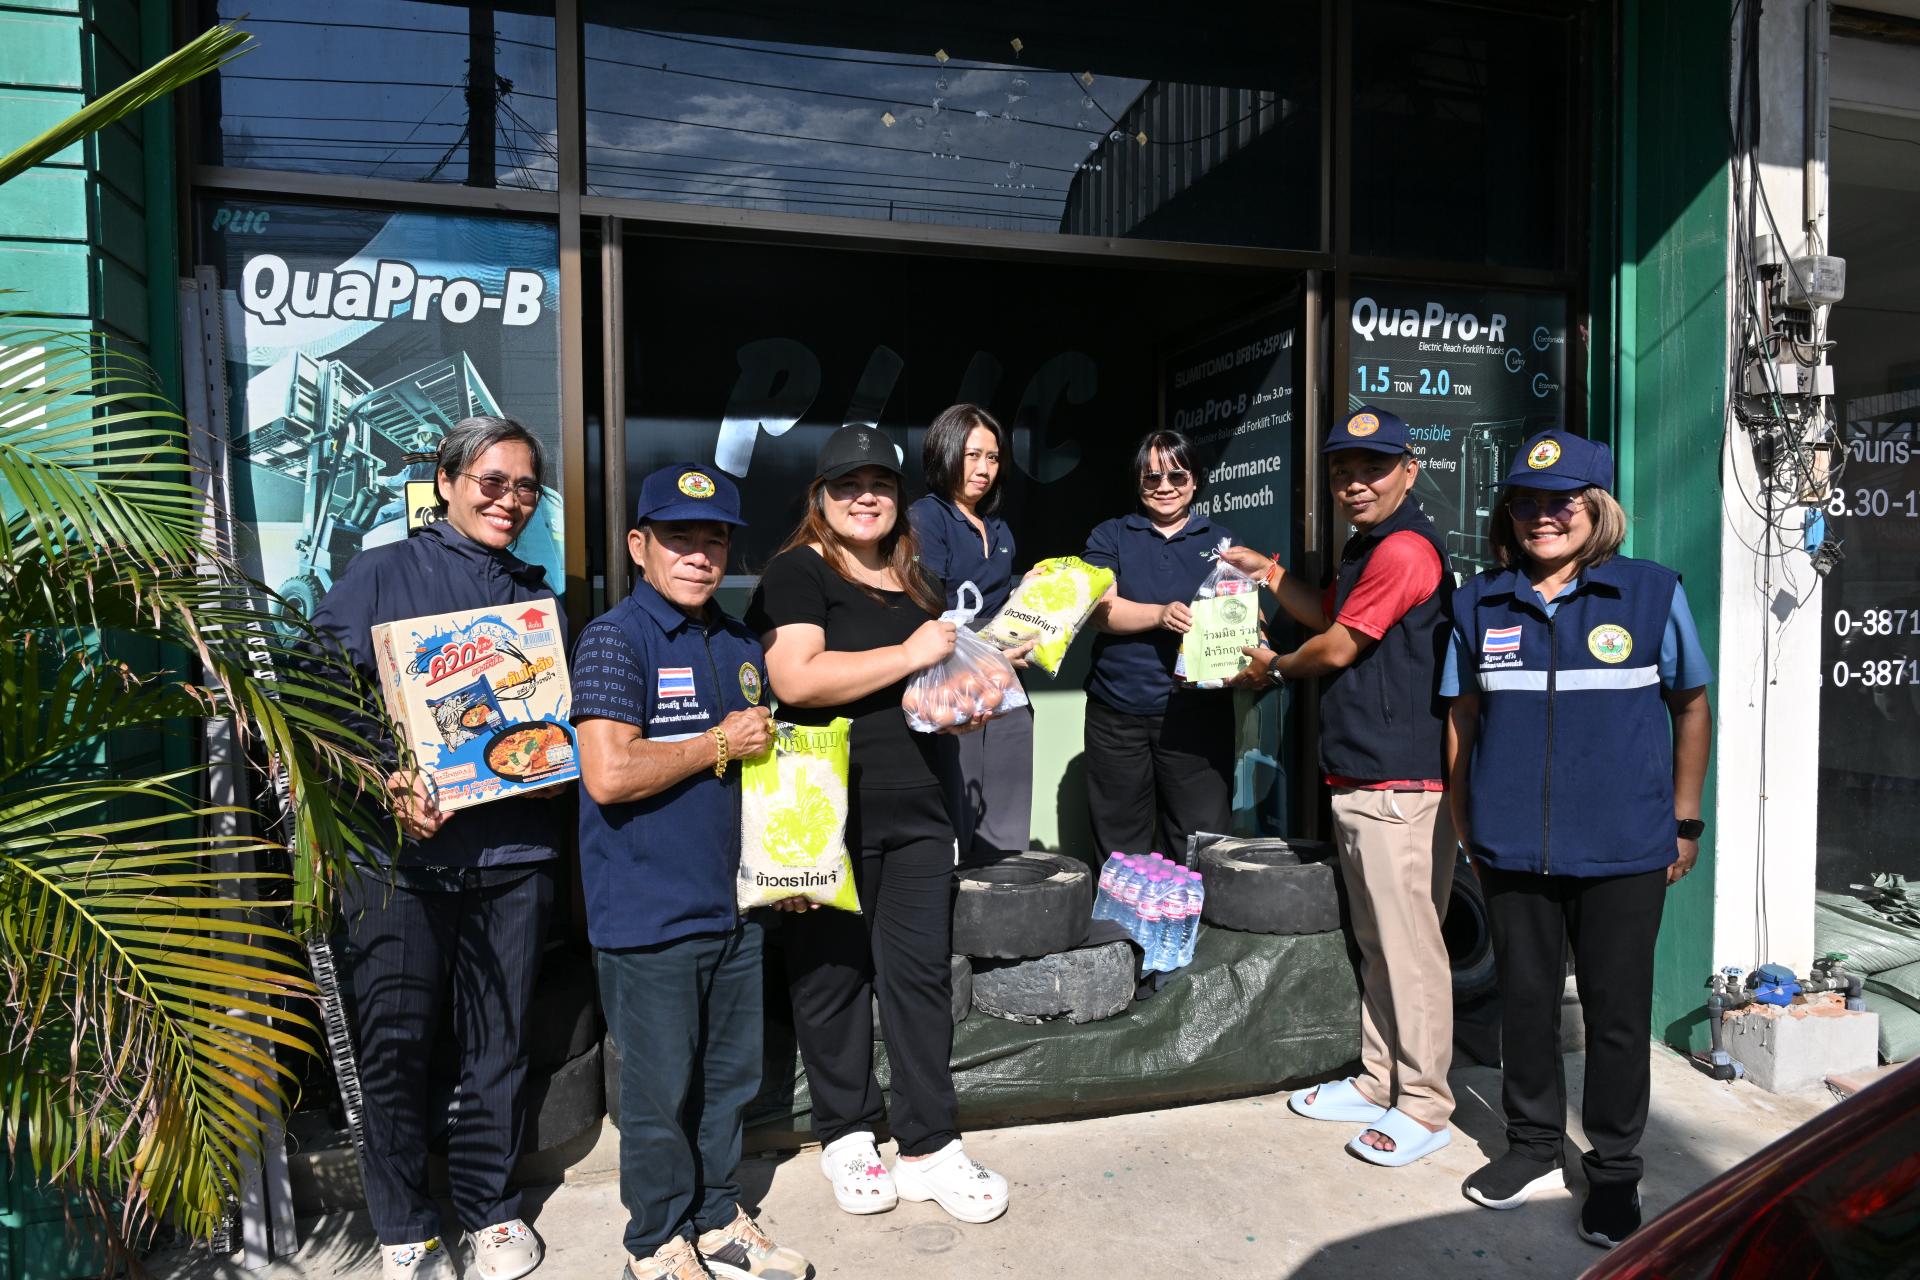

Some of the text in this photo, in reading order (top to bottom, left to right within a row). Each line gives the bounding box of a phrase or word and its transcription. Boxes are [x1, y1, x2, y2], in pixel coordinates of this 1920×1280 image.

[212, 208, 270, 234] PLIC
[240, 253, 545, 325] QuaPro-B
[1351, 296, 1507, 342] QuaPro-R
[1418, 342, 1504, 355] Electric Reach Forklift Trucks
[1357, 365, 1472, 396] 1.5 TON 2.0 TON
[1174, 393, 1248, 432] QuaPro-B
[1252, 394, 1262, 405] 1.0
[1272, 387, 1284, 399] 3.0
[1246, 416, 1271, 432] Forklift
[1403, 422, 1451, 441] ensible
[1429, 457, 1457, 472] feeling
[1212, 494, 1222, 513] &
[1224, 484, 1274, 512] Smooth
[1827, 487, 1920, 517] 8.30-1
[1203, 627, 1236, 641] ร่วมมือ
[429, 642, 477, 680] ควิก
[1833, 659, 1920, 687] 0-3871
[604, 681, 626, 692] you
[756, 870, 838, 887] ข้าวตราไก่แจ้
